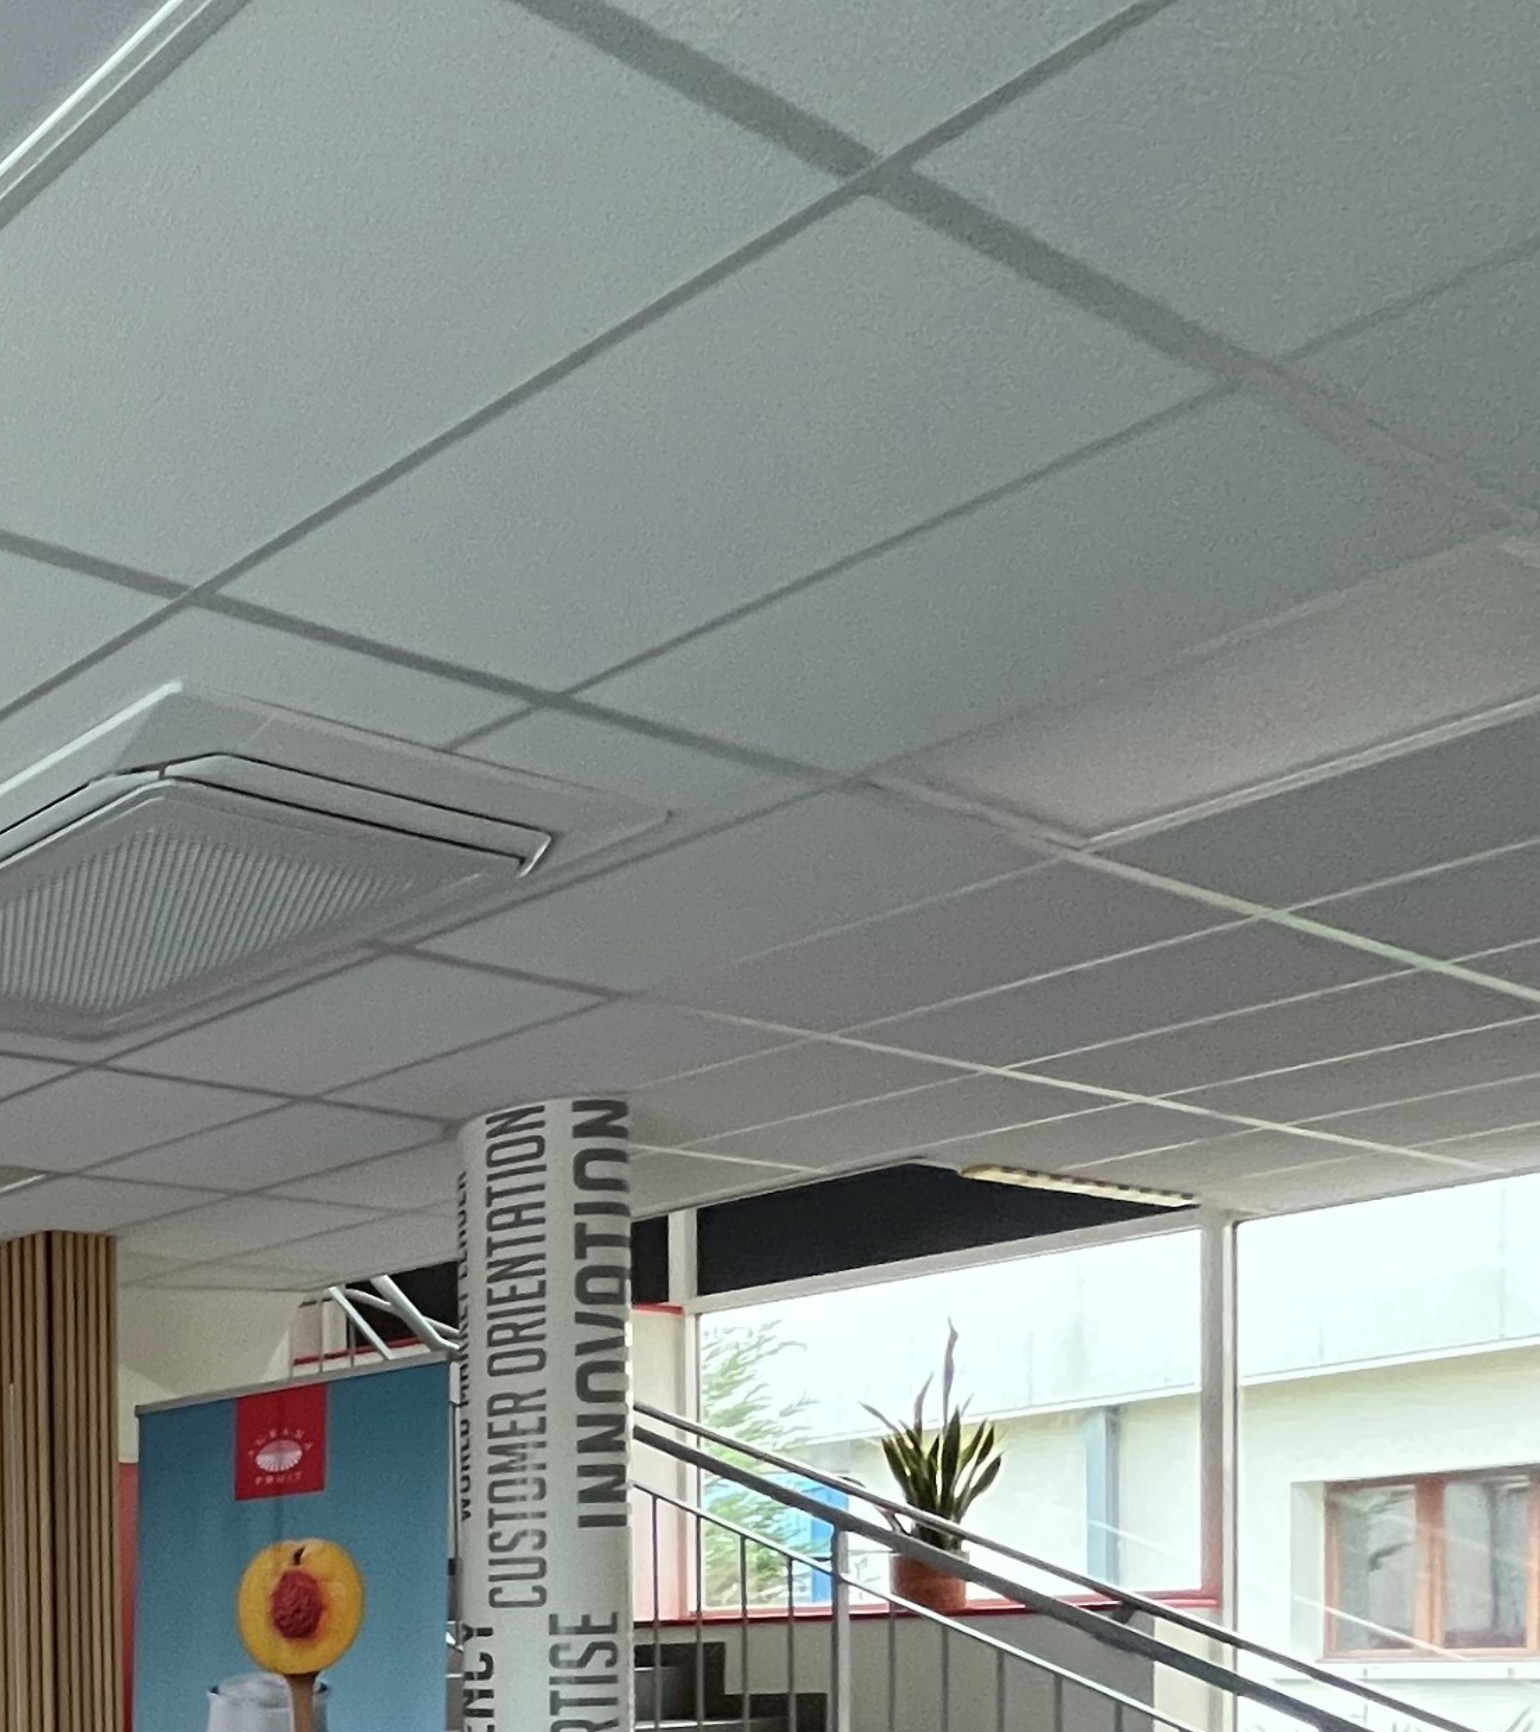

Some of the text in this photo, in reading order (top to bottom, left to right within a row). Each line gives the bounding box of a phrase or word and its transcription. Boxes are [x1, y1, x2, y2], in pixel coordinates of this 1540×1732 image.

[485, 1104, 548, 1609] CUSTOMER ORIENTATION
[572, 1100, 631, 1528] INNOVATION
